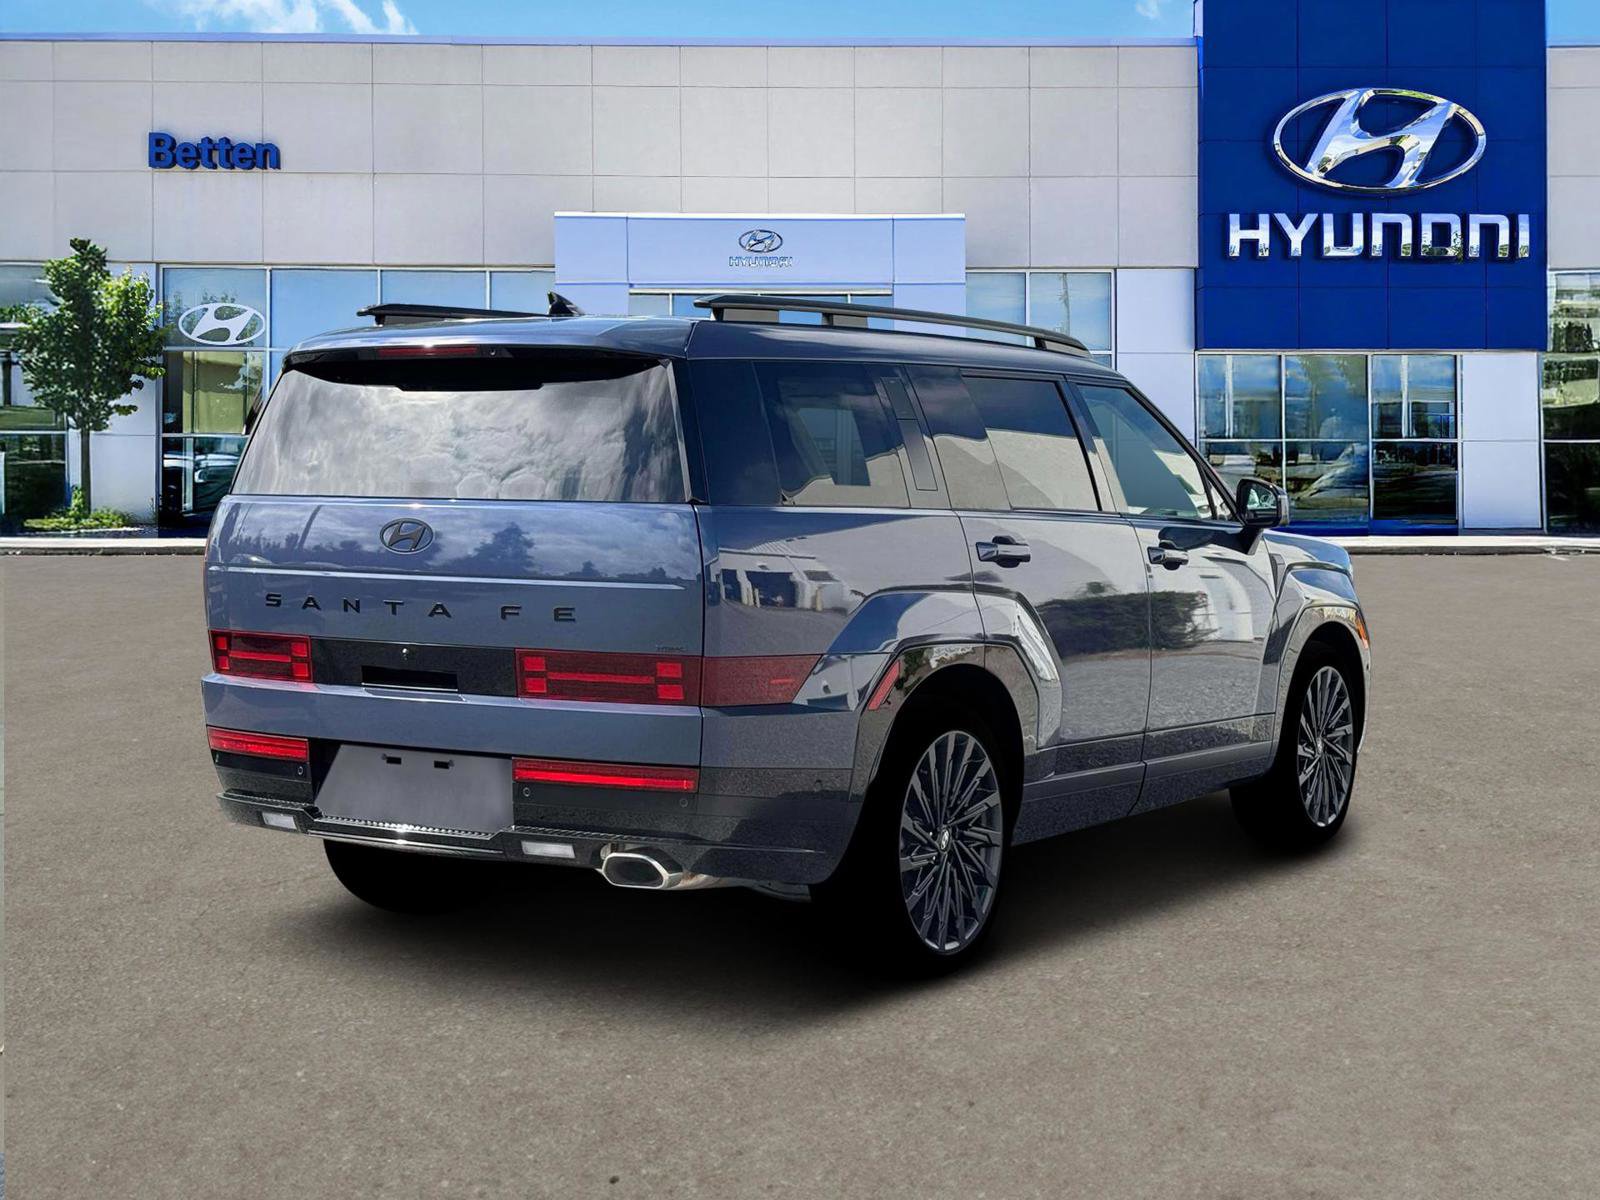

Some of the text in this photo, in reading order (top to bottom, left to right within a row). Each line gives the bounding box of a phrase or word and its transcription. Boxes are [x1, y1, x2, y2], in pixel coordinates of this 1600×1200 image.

[148, 132, 281, 170] Betten
[1228, 213, 1530, 258] HYUNDAI
[728, 256, 793, 268] HYUNDAI
[265, 593, 577, 622] SANTA FE
